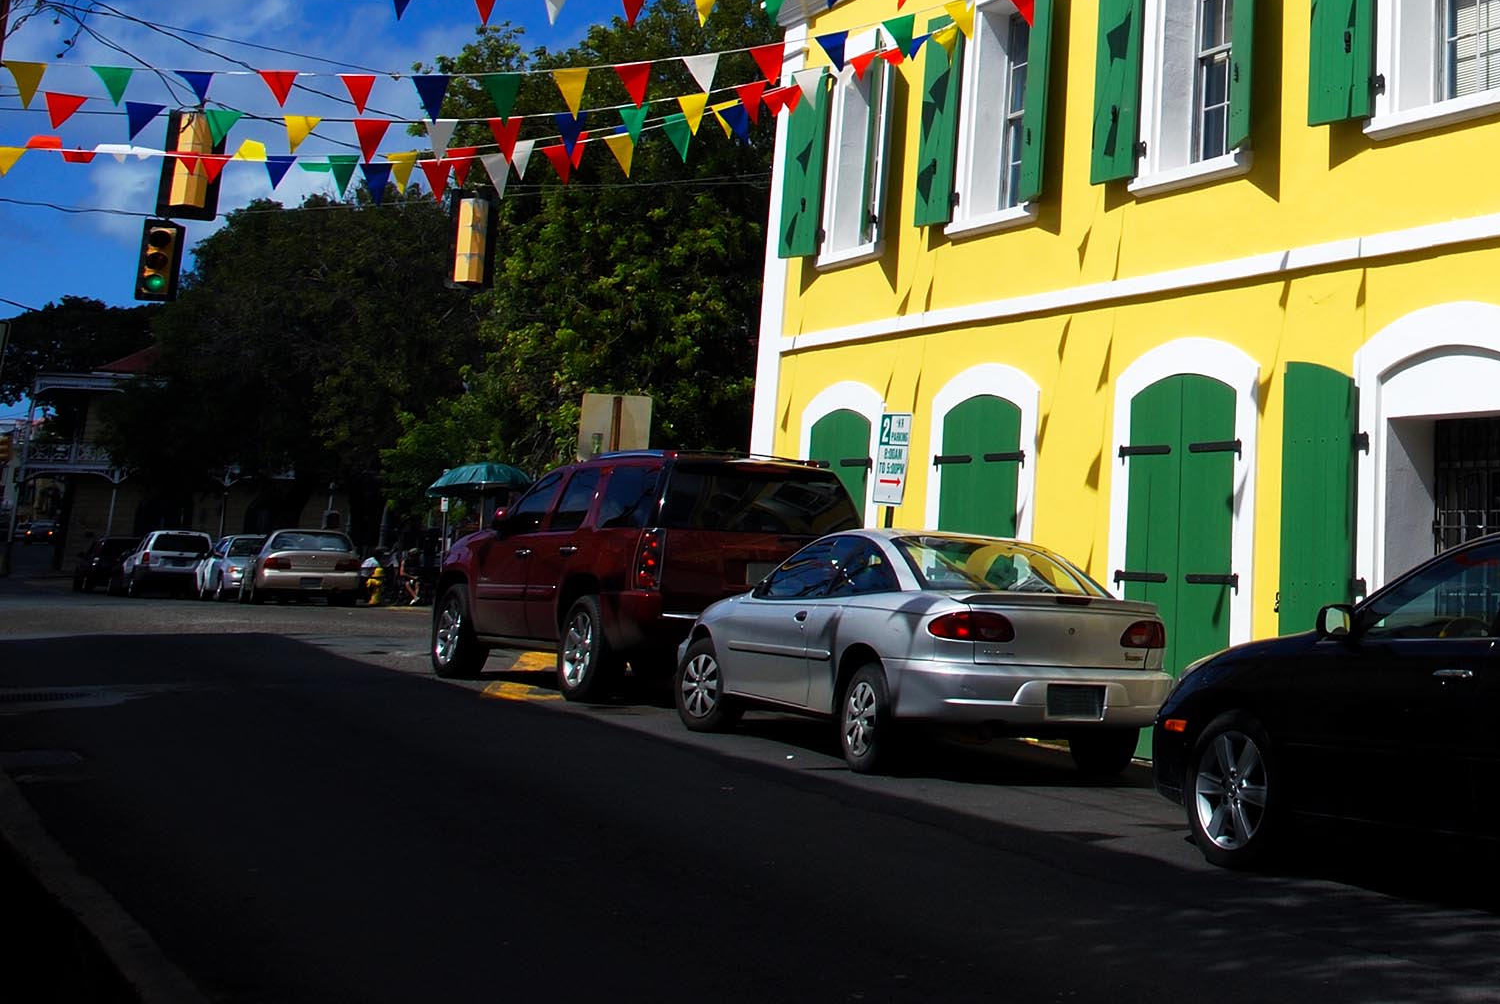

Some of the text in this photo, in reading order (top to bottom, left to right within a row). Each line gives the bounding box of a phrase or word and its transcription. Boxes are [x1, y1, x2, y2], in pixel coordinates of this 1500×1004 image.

[881, 418, 890, 443] 2
[891, 432, 908, 442] PARKING
[879, 462, 886, 474] TO
